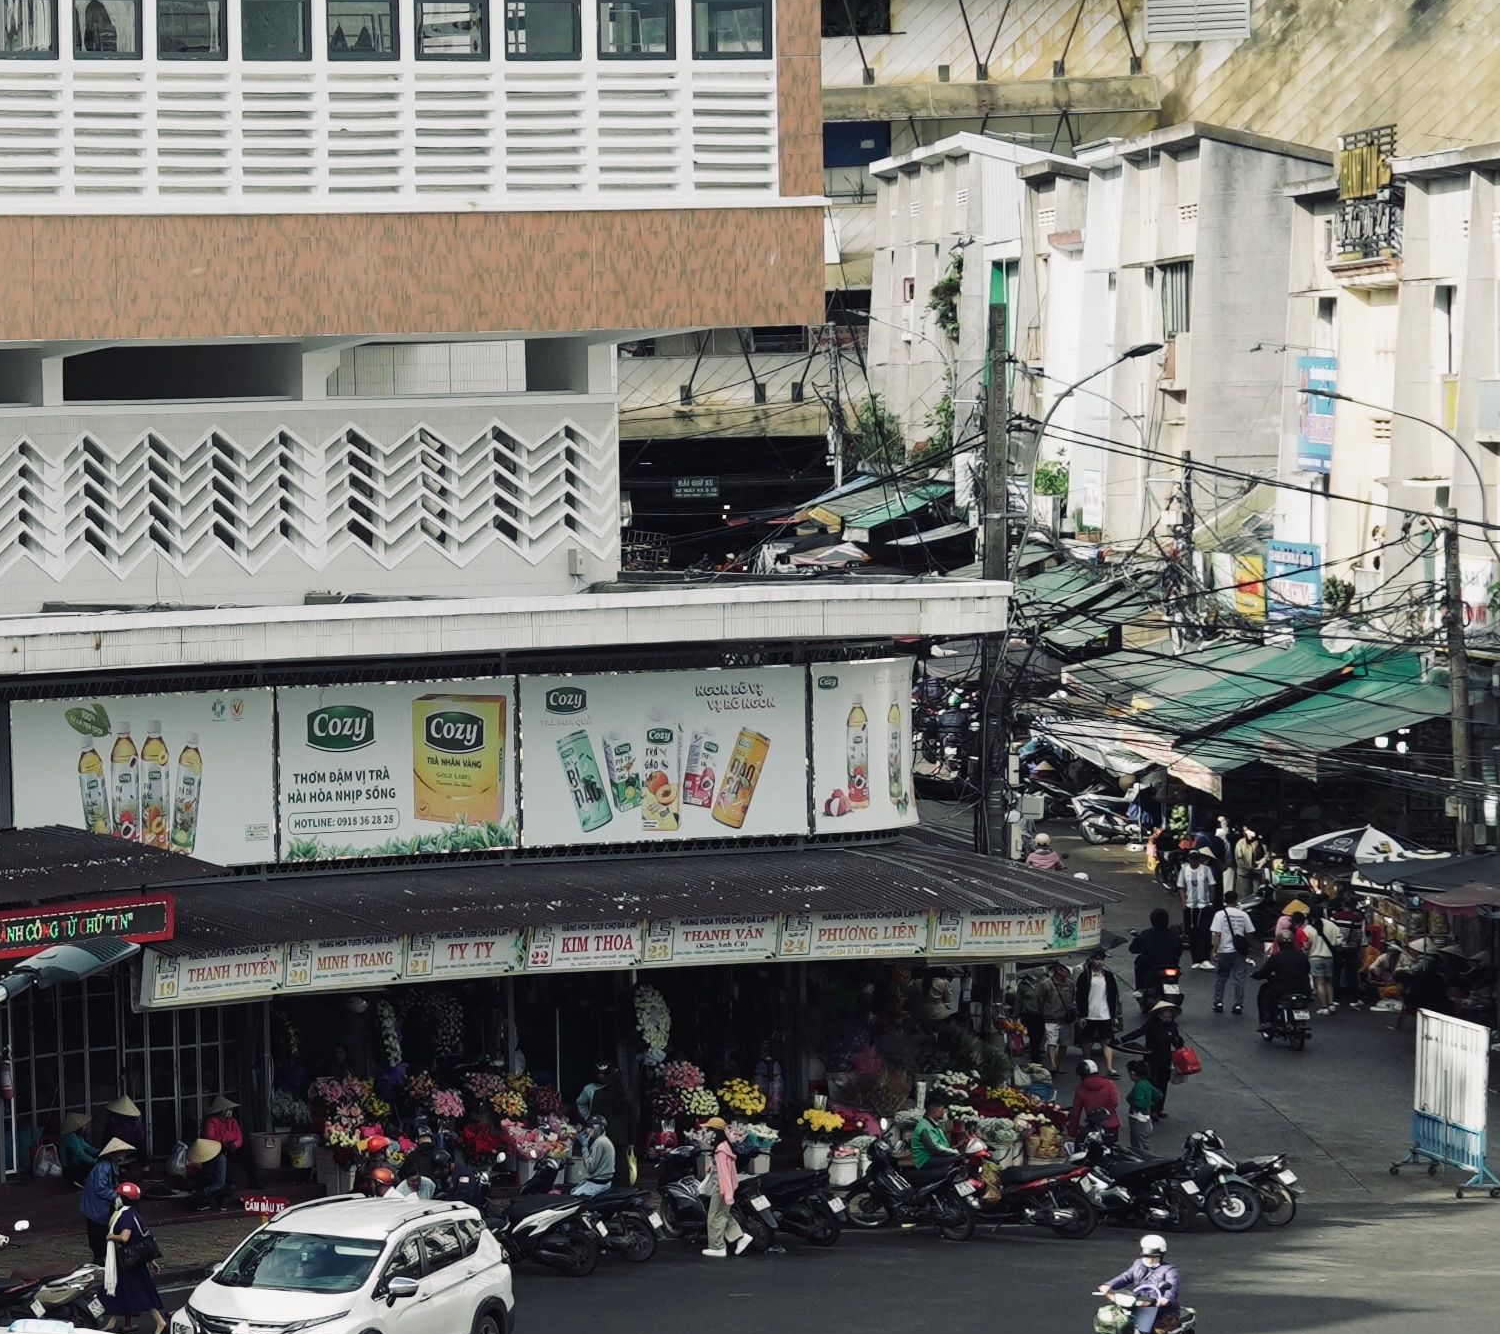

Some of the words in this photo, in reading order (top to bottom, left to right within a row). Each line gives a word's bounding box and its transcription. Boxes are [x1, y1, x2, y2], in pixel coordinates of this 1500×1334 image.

[550, 691, 583, 708] Cozy
[312, 713, 368, 741] Cozy
[430, 716, 479, 746] Cozy
[648, 729, 672, 742] Cozy
[293, 769, 328, 785] THƠM
[329, 768, 353, 786] ĐẬM
[354, 770, 366, 785] VỊ
[368, 766, 390, 781] TRÀ
[288, 787, 306, 804] HÀI
[309, 788, 333, 803] HÒA
[335, 790, 363, 806] NHỊP
[365, 785, 396, 801] SỐNG
[336, 816, 357, 827] 0918
[25, 919, 59, 941] CÔNG
[682, 929, 731, 942] THANH
[735, 925, 764, 940] VÂN
[817, 925, 878, 942] PHƯƠNG
[883, 921, 918, 939] LIÊN
[970, 921, 1012, 937] MINH
[1016, 916, 1046, 936] TÂM
[447, 942, 469, 960] TY
[473, 941, 495, 958] TY
[561, 935, 590, 953] KIM
[593, 933, 634, 952] THOA
[647, 945, 669, 959] 23
[784, 938, 806, 953] 24
[317, 954, 349, 971] MINH
[352, 951, 394, 968] TRANG
[410, 959, 428, 973] 21
[530, 950, 549, 965] 22
[289, 969, 308, 983] 20
[160, 981, 176, 996] 19
